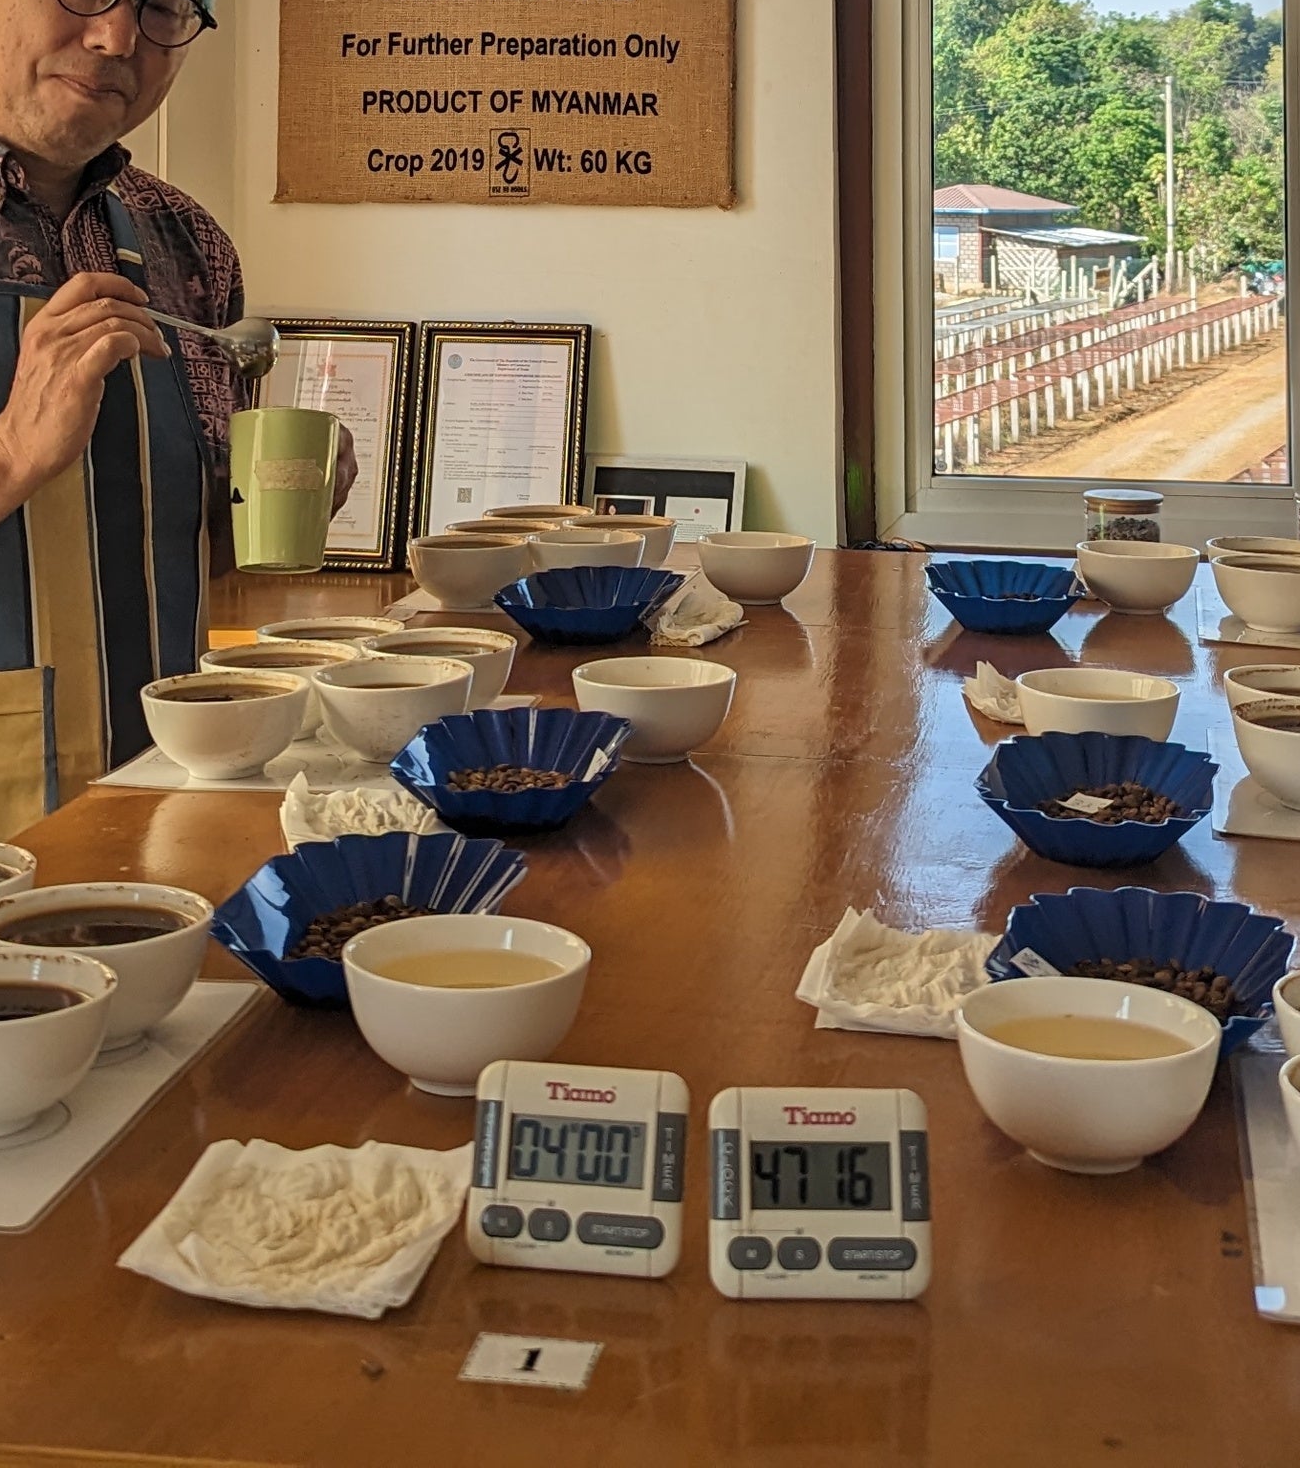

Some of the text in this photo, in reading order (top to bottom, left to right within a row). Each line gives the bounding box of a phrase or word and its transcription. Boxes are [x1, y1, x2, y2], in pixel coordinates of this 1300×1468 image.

[342, 32, 680, 64] For Further Preparation Only
[363, 90, 659, 116] PRODUCT OF MYANMAR
[368, 148, 651, 177] Crop 2019 Wt: 60 KG
[546, 1082, 616, 1103] Tiamo
[784, 1107, 856, 1124] Tiamo
[723, 1142, 735, 1206] CLOCK
[908, 1146, 922, 1210] TIMER
[513, 1347, 542, 1372] 1
